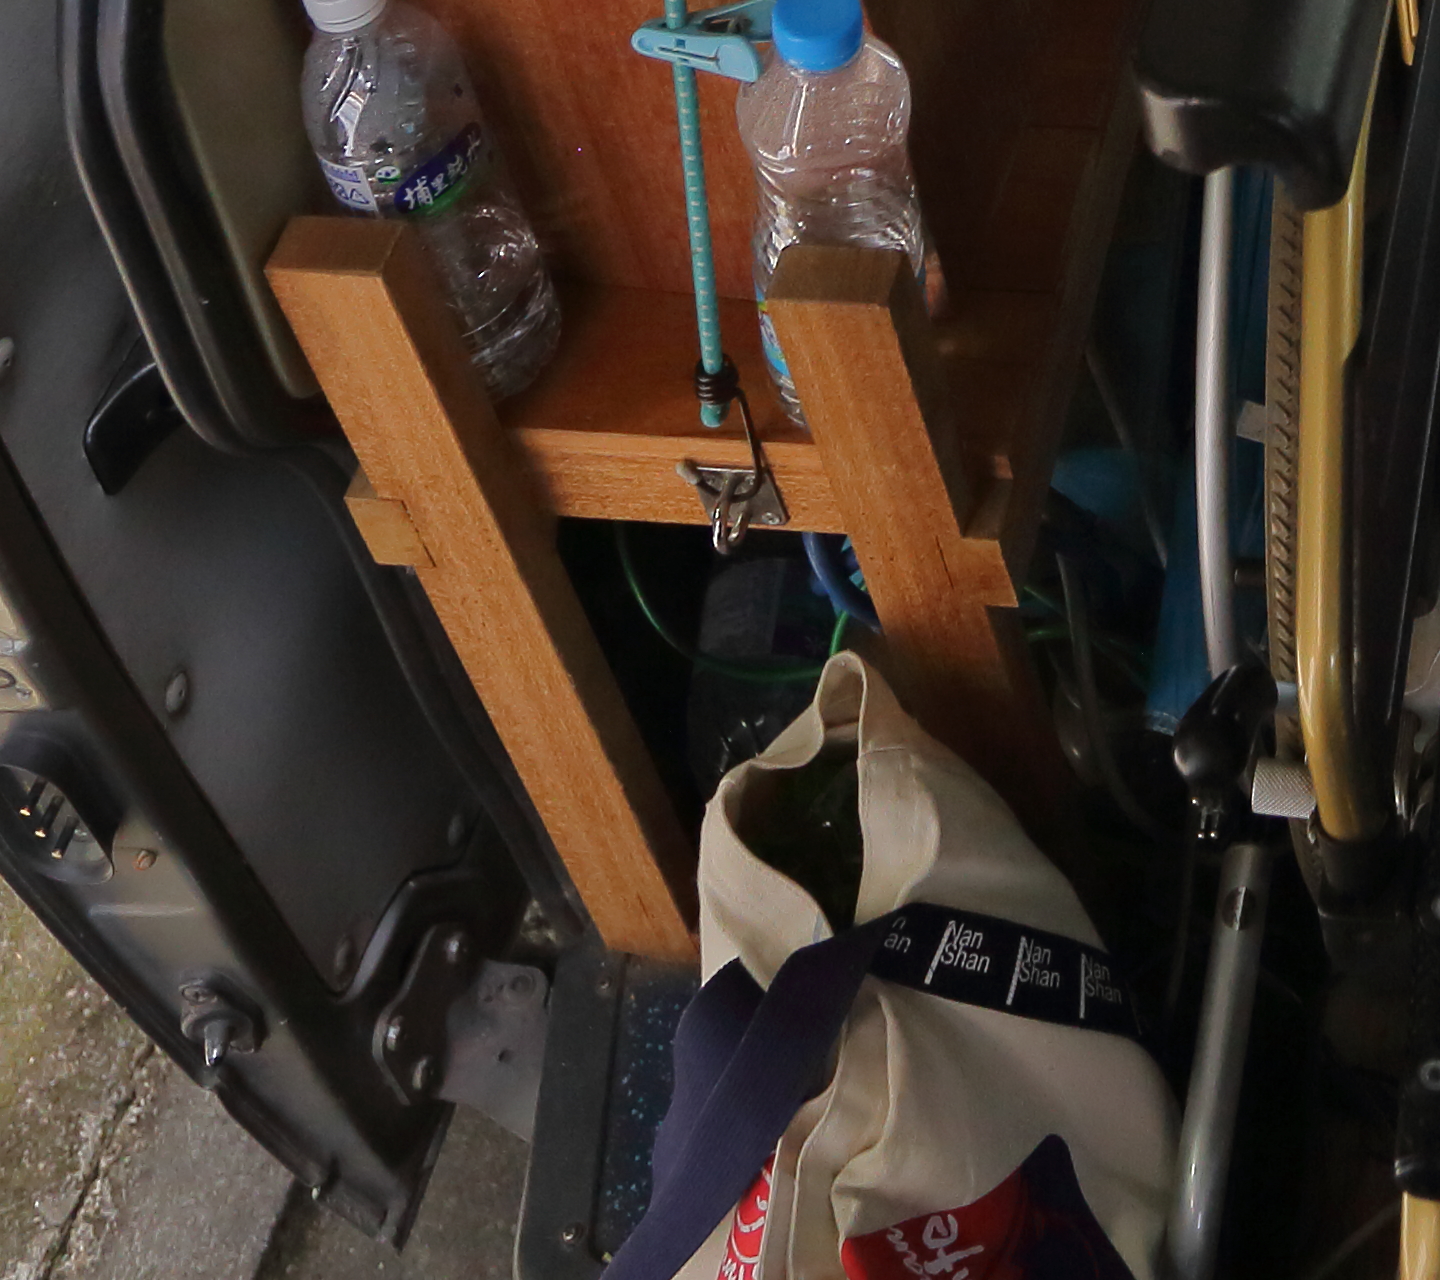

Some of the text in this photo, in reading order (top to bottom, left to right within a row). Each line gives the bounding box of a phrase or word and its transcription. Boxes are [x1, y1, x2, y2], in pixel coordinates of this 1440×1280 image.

[944, 919, 984, 950] Nan
[940, 942, 991, 974] Shan
[1018, 935, 1052, 966] Nan
[1016, 961, 1061, 989] Shan
[1080, 952, 1110, 981] Nan
[1084, 978, 1123, 1005] Shan
